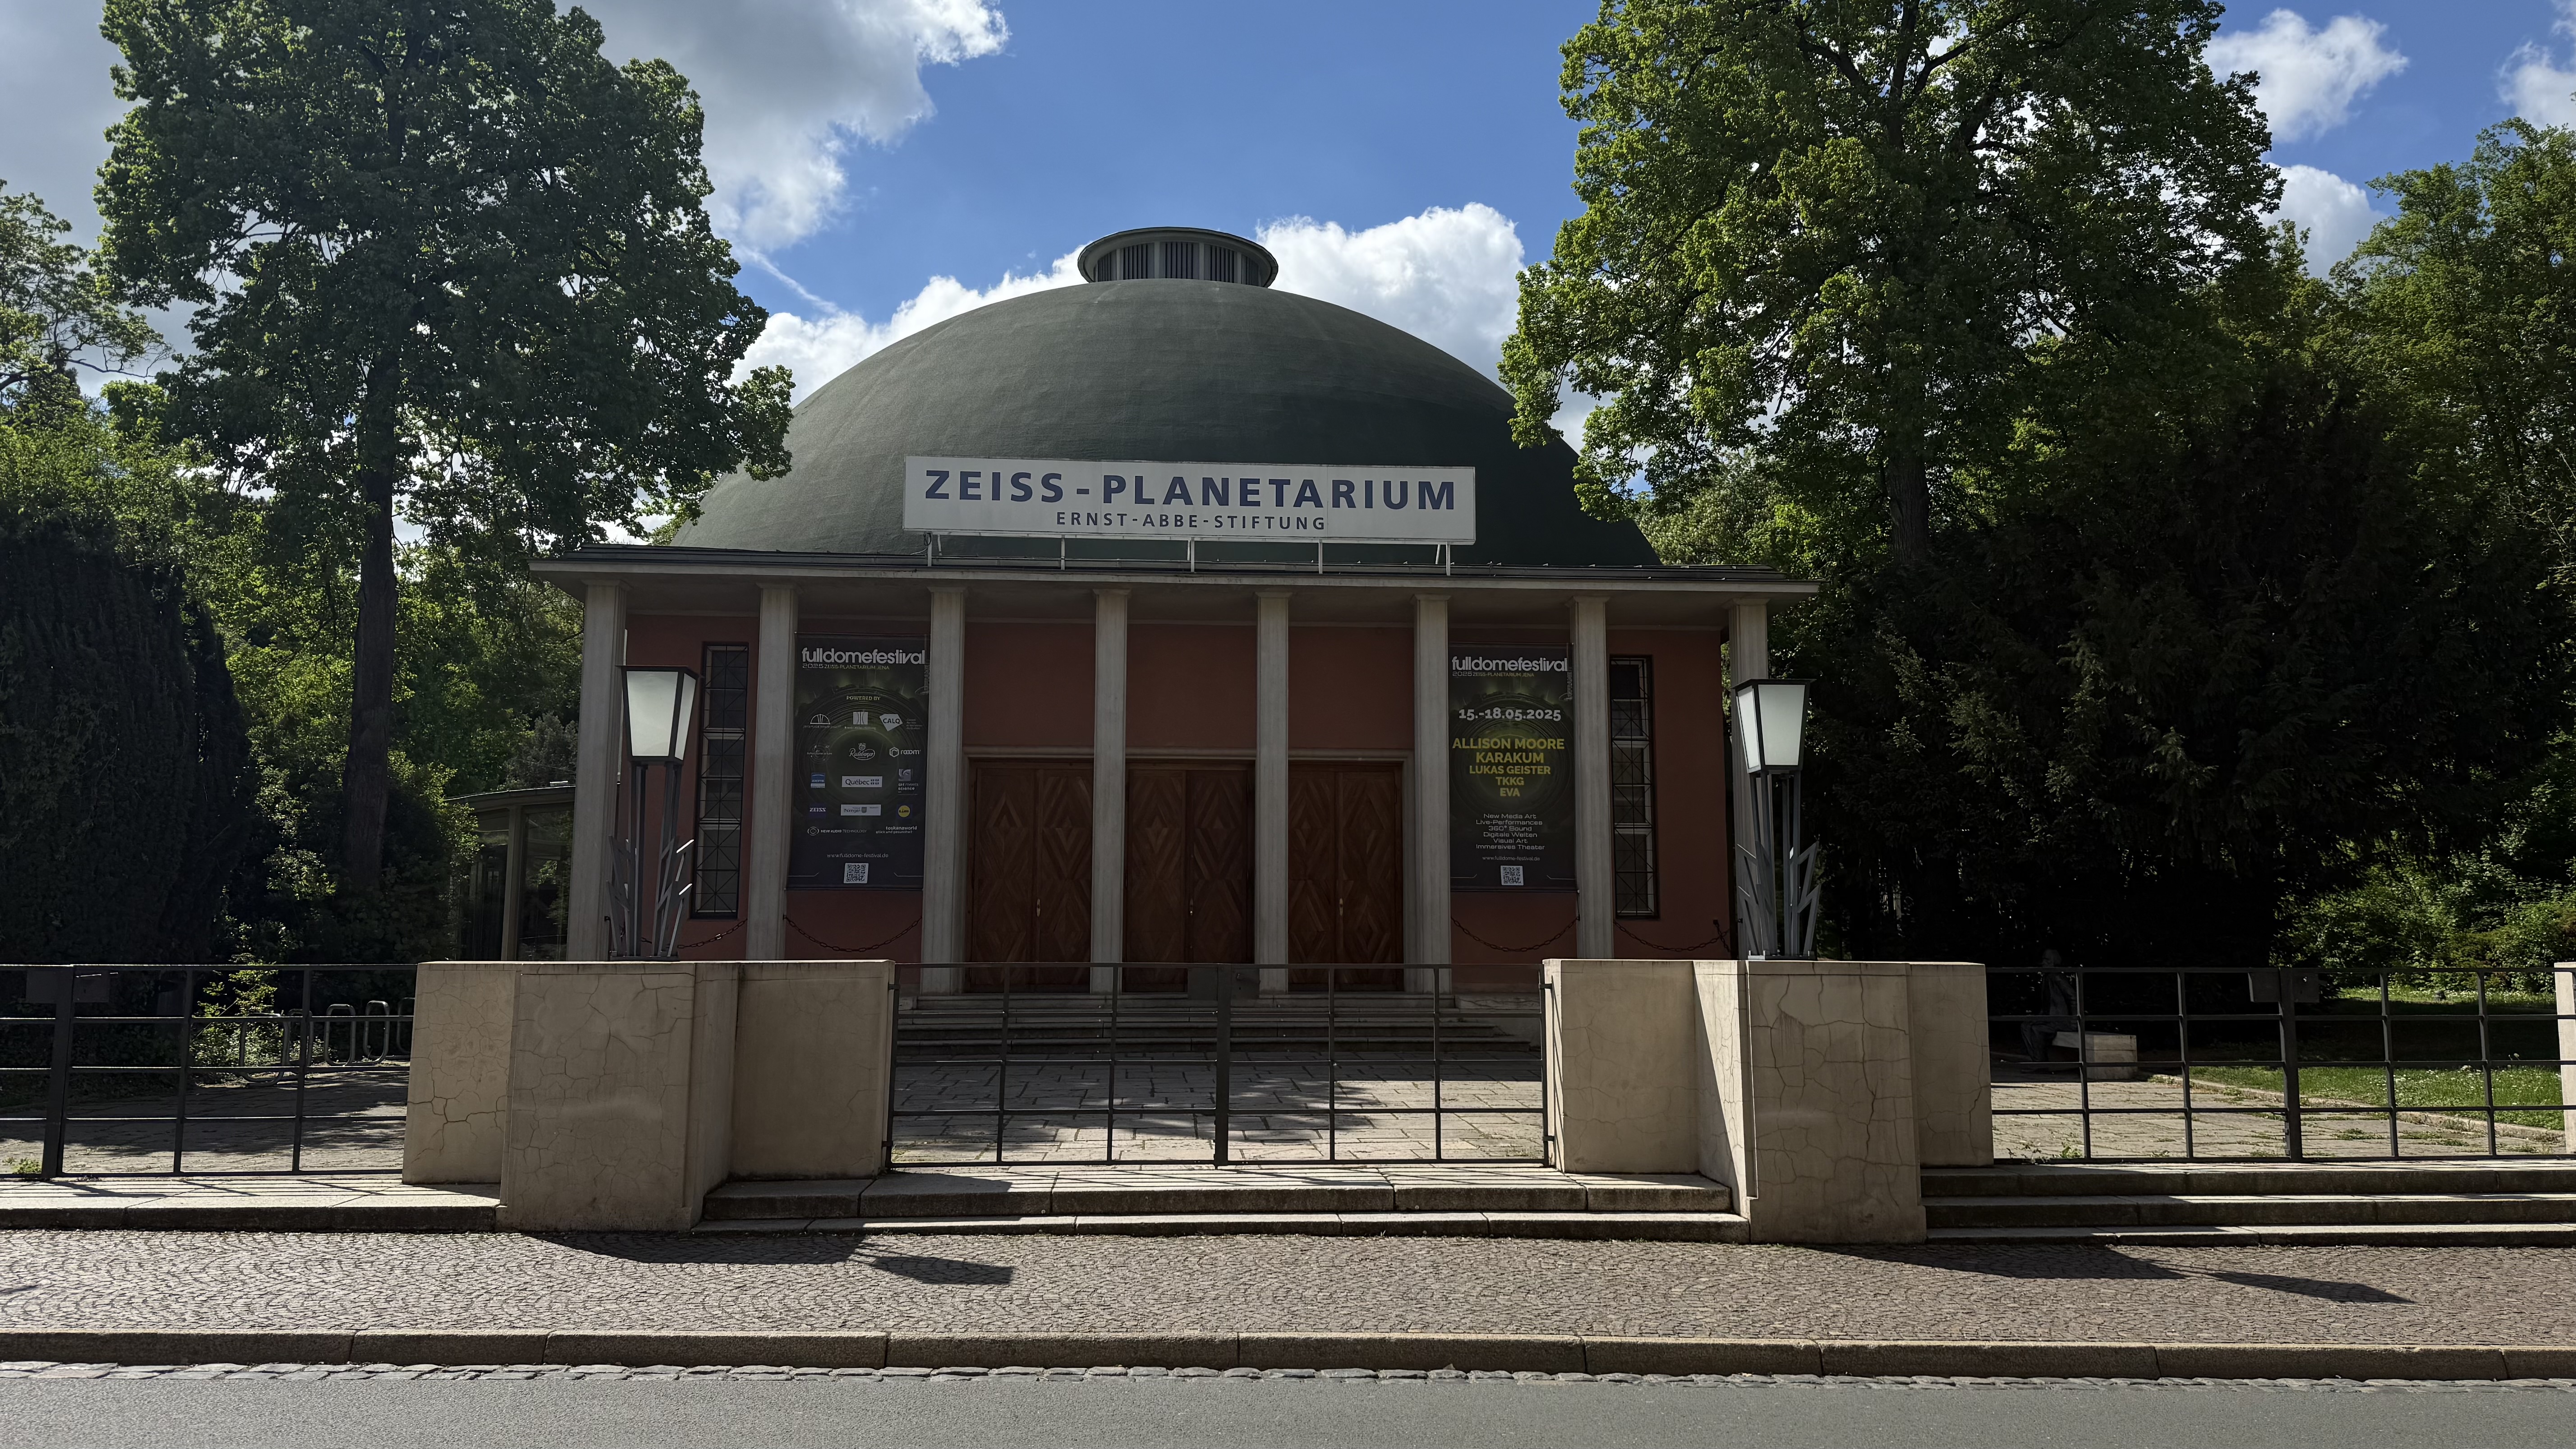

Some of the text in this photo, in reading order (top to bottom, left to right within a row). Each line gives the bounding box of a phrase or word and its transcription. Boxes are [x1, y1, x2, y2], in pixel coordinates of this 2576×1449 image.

[926, 470, 1454, 510] ZEISS-PLANETARIUM
[1056, 512, 1325, 530] ERNST-ABBE-STIFTUNG
[801, 647, 925, 664] fulldomefestival
[1452, 656, 1568, 672] fulldomefestival
[1458, 707, 1561, 722] 15.-18.05.2025
[1452, 738, 1565, 750] ALLISON MOORE
[1476, 752, 1544, 763] KARAKUM
[1469, 765, 1551, 774] LUKAS GEISTER
[1495, 777, 1524, 786] TKKG
[1500, 788, 1520, 796] EVA
